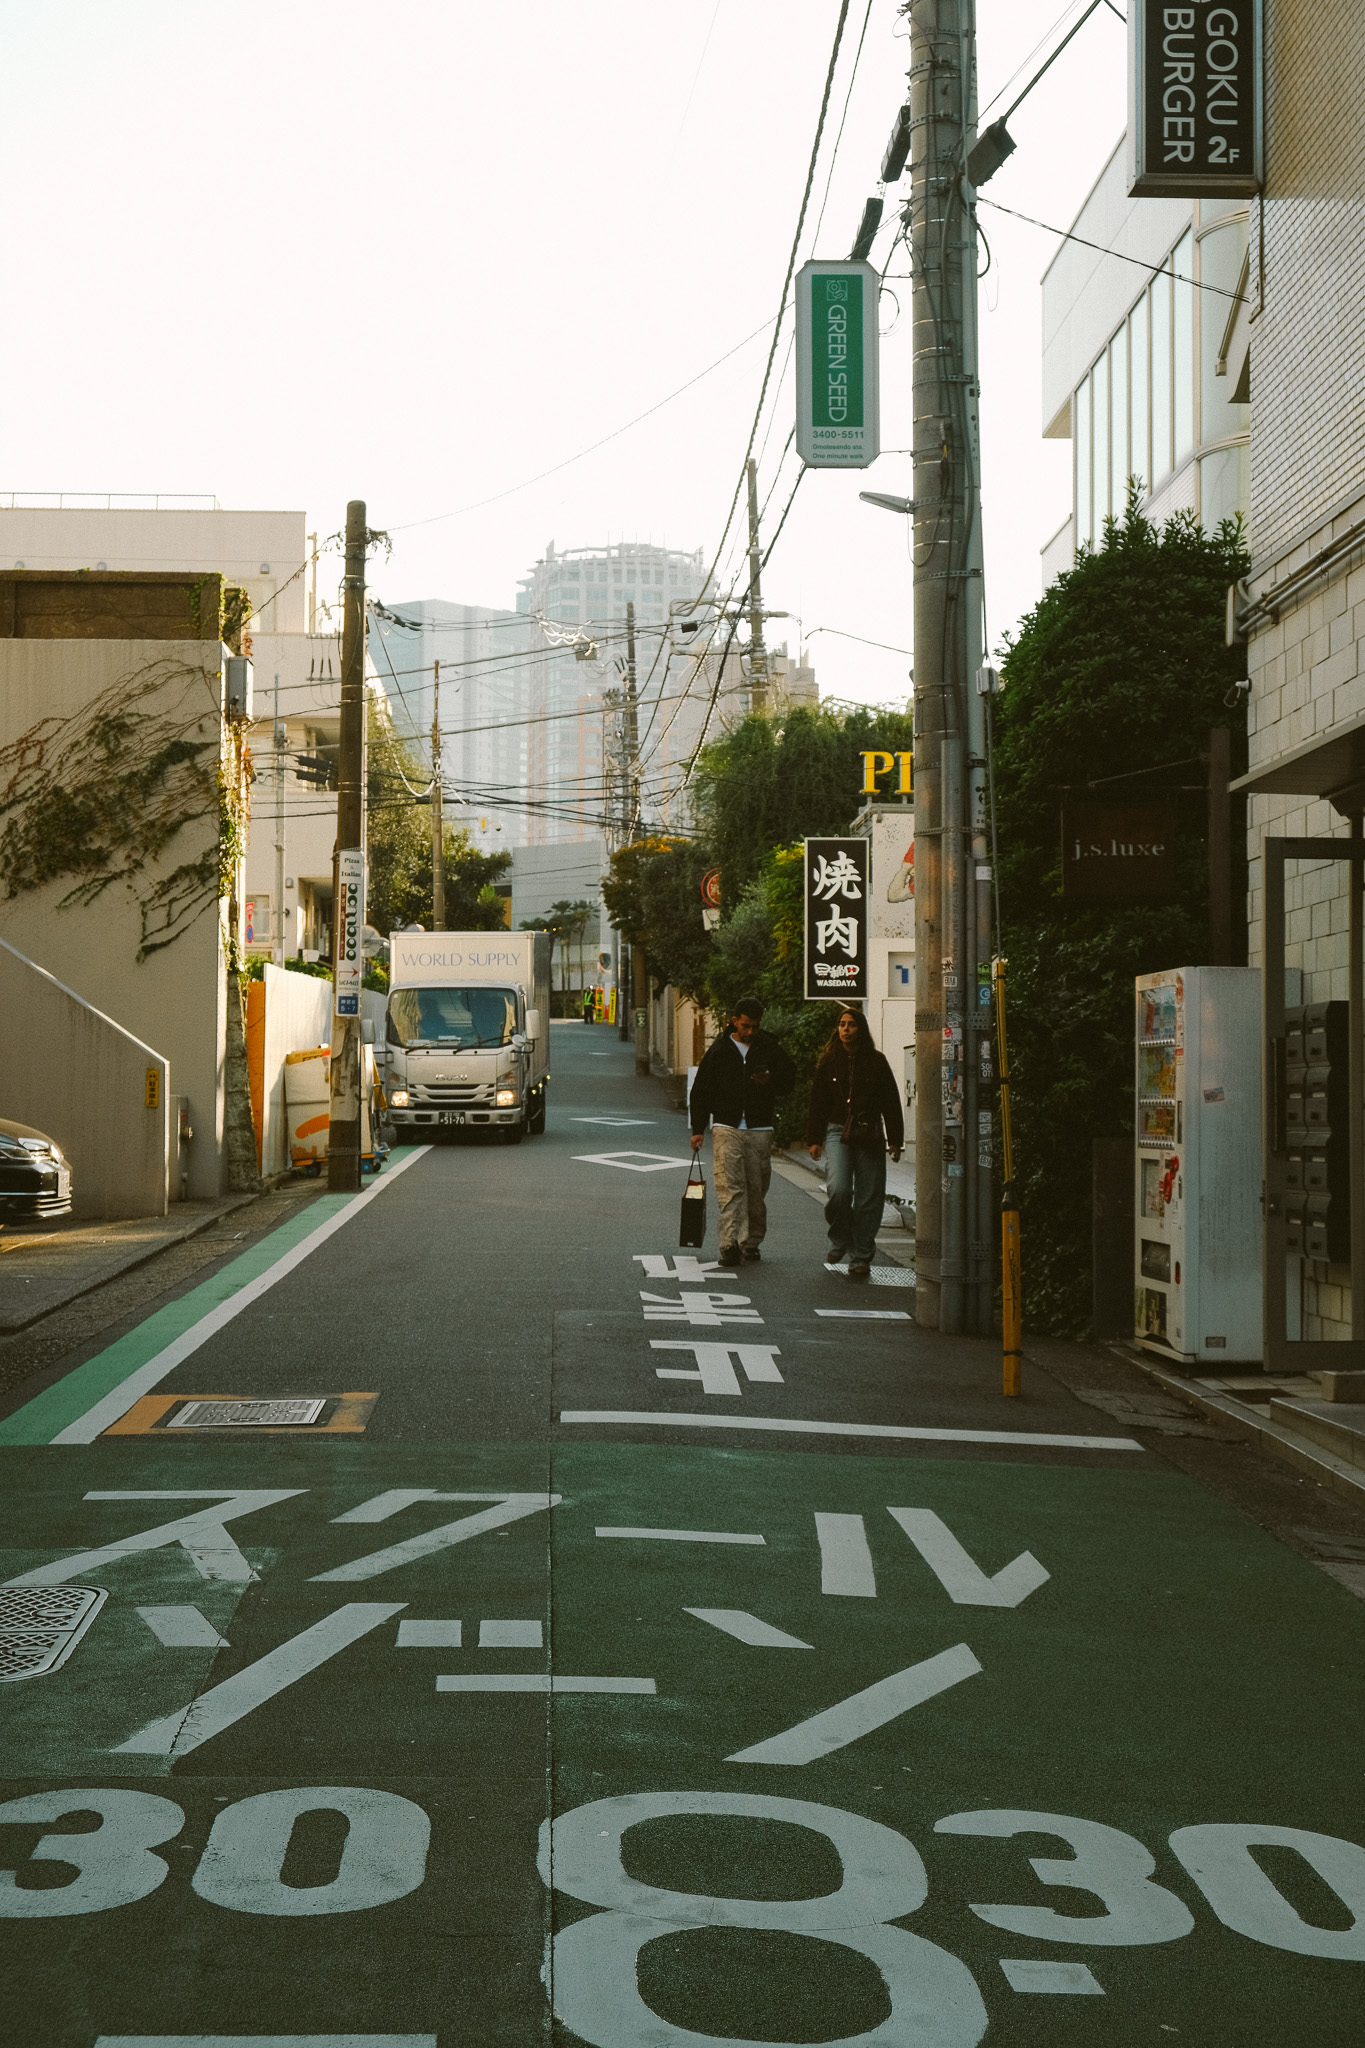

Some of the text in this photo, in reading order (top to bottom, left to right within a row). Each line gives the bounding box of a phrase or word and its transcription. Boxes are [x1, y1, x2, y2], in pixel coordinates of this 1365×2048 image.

[1162, 8, 1196, 163] BURGER
[1206, 8, 1239, 126] GOKU
[1207, 135, 1240, 164] 2F
[828, 304, 848, 422] GREEN SEED
[812, 430, 864, 439] 3400-5511
[812, 850, 862, 959] 焼肉
[1071, 839, 1165, 861] j.s.luxe
[402, 952, 521, 966] WORLD SUPPLY
[816, 979, 857, 987] WASEDAYA
[0, 1488, 1052, 1608] スクール
[108, 1601, 984, 1766] ゾーン
[0, 1787, 1365, 2048] 30 8 30
